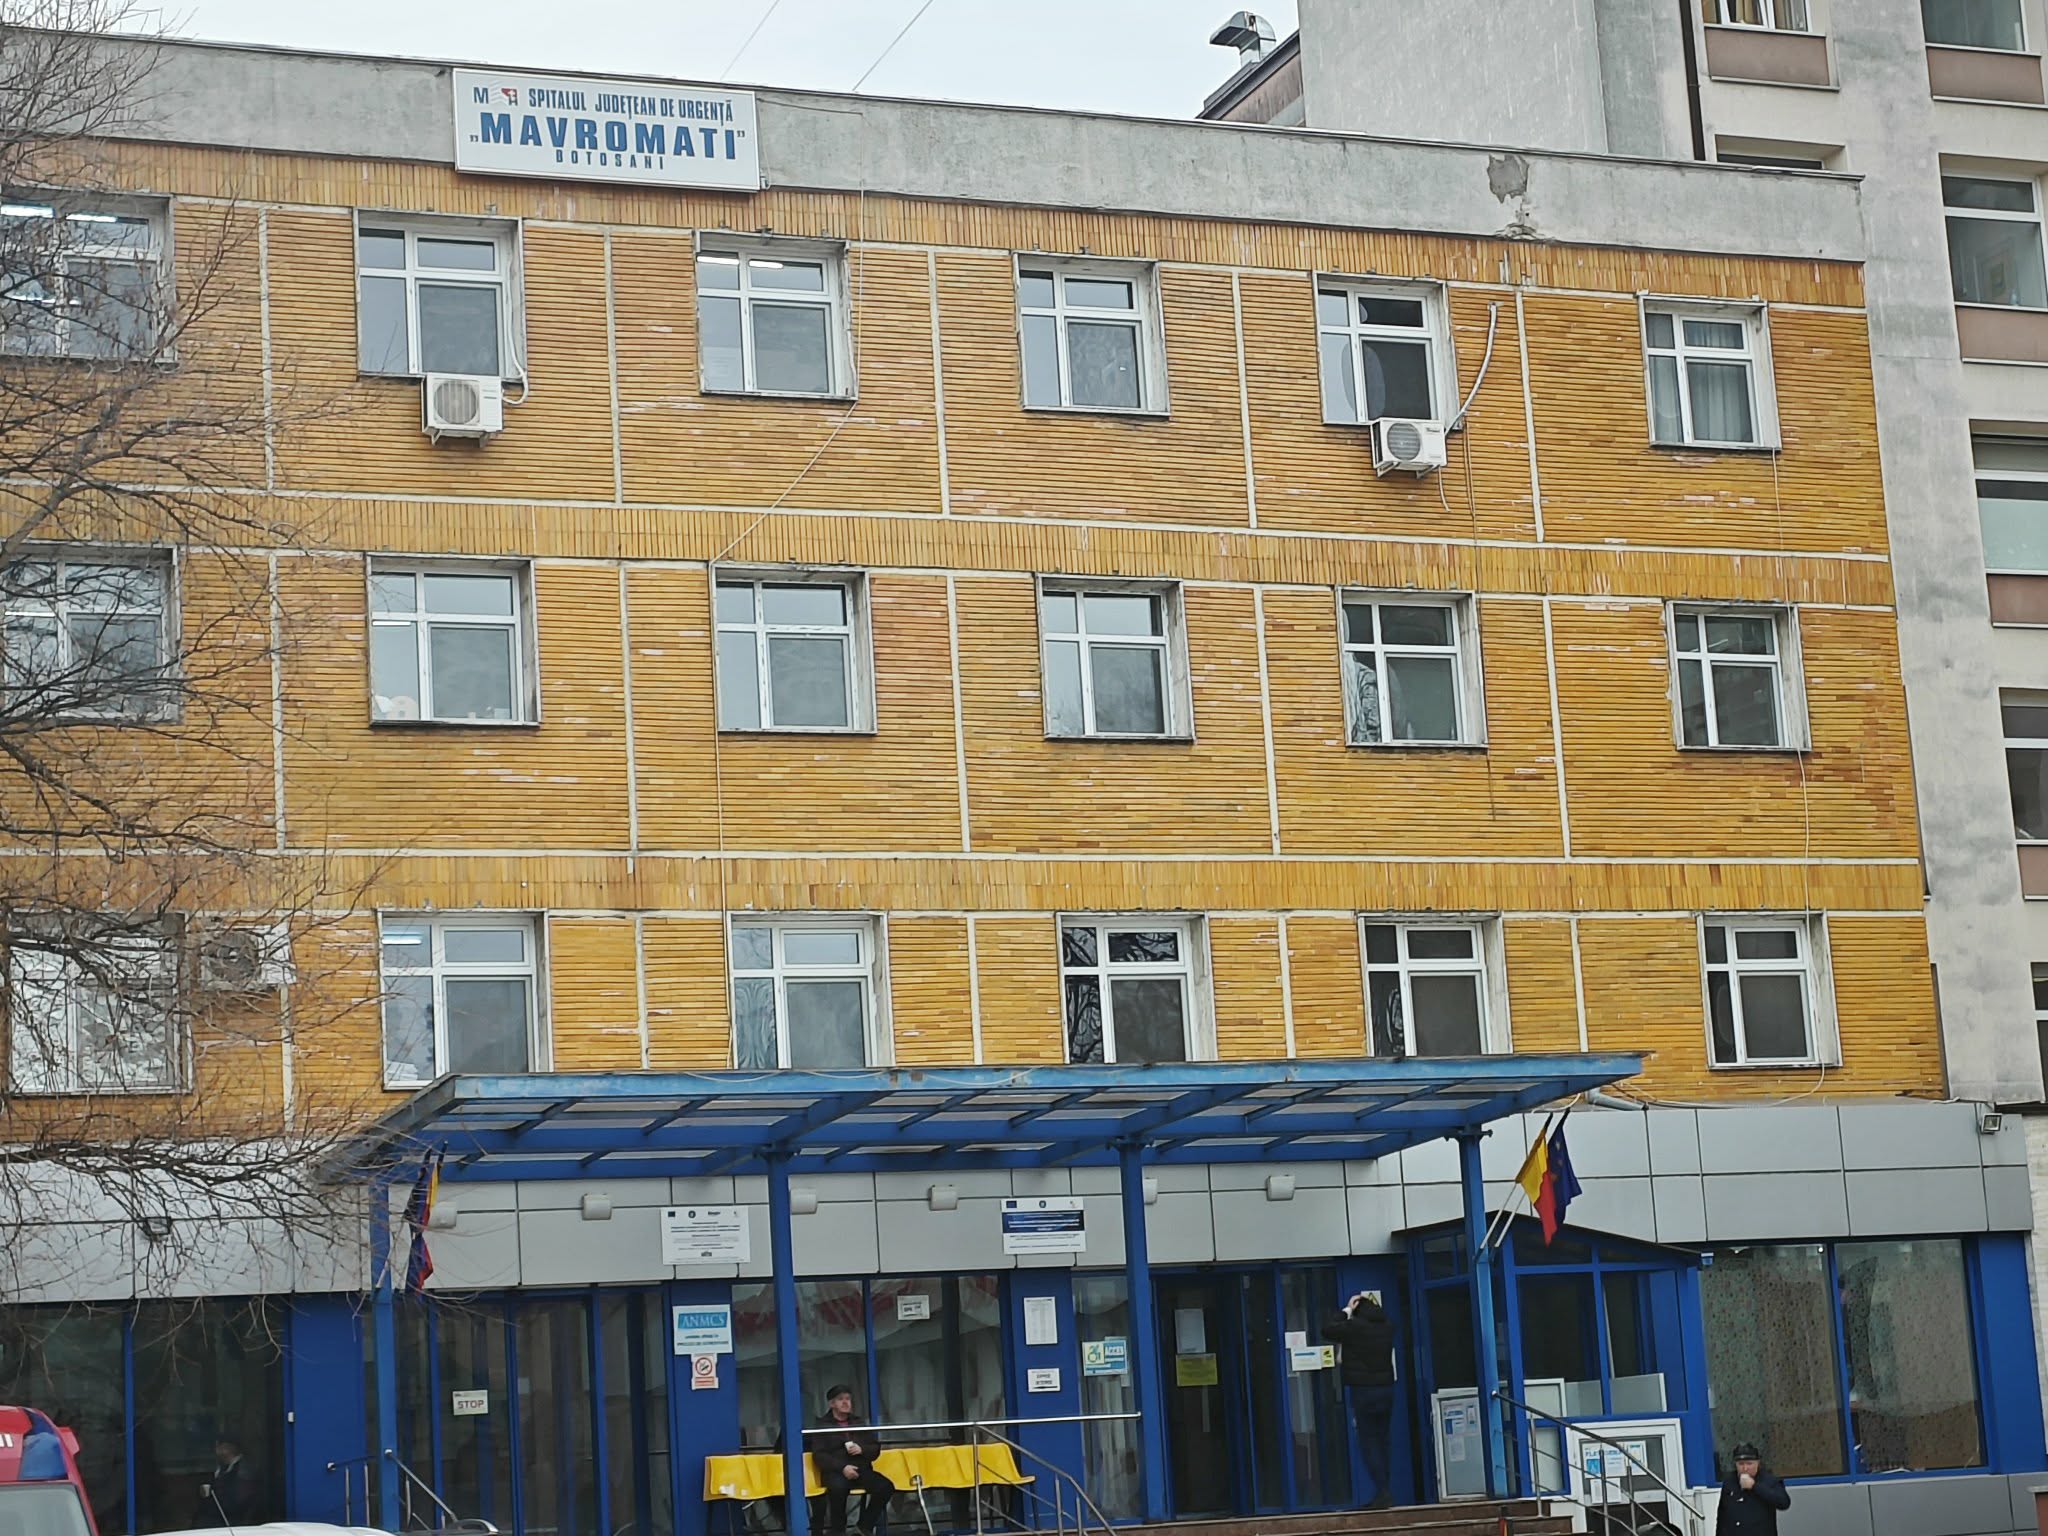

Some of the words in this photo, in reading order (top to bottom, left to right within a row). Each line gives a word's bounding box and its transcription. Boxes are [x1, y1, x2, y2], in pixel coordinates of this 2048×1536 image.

[528, 88, 587, 111] SPITALUL
[595, 93, 656, 120] JUDEȚEAN
[660, 97, 675, 117] DE
[678, 99, 733, 126] URGENȚĂ
[681, 1314, 726, 1328] ANMCS
[457, 1400, 485, 1409] STOP
